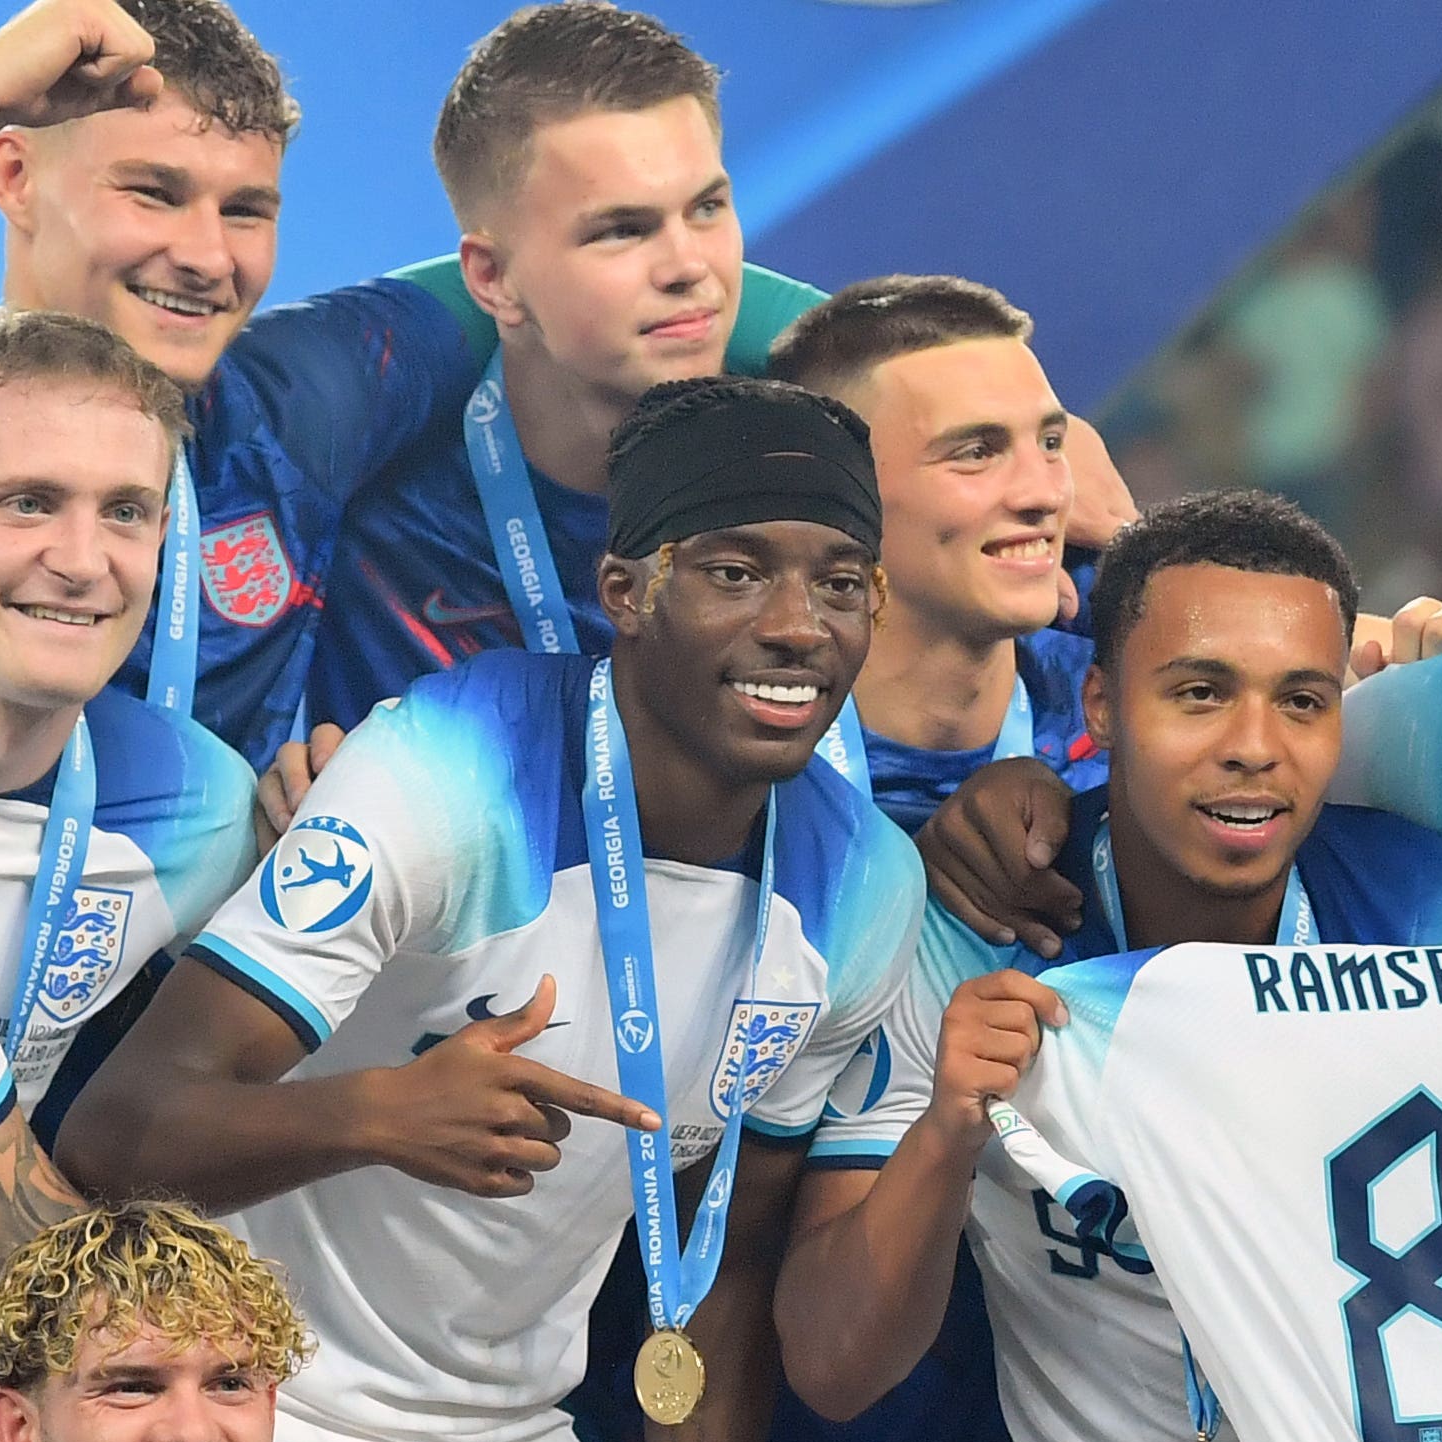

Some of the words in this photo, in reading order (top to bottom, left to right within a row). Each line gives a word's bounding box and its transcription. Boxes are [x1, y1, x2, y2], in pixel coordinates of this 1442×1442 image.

[170, 551, 189, 641] GEORGIA
[506, 517, 546, 609] GEORGIA
[593, 704, 617, 801] ROMANIA
[45, 818, 78, 907] GEORGIA
[604, 816, 630, 909] GEORGIA
[18, 922, 52, 1017] ROMANIA
[642, 1128, 656, 1161] 20
[643, 1166, 663, 1265] ROMANIA
